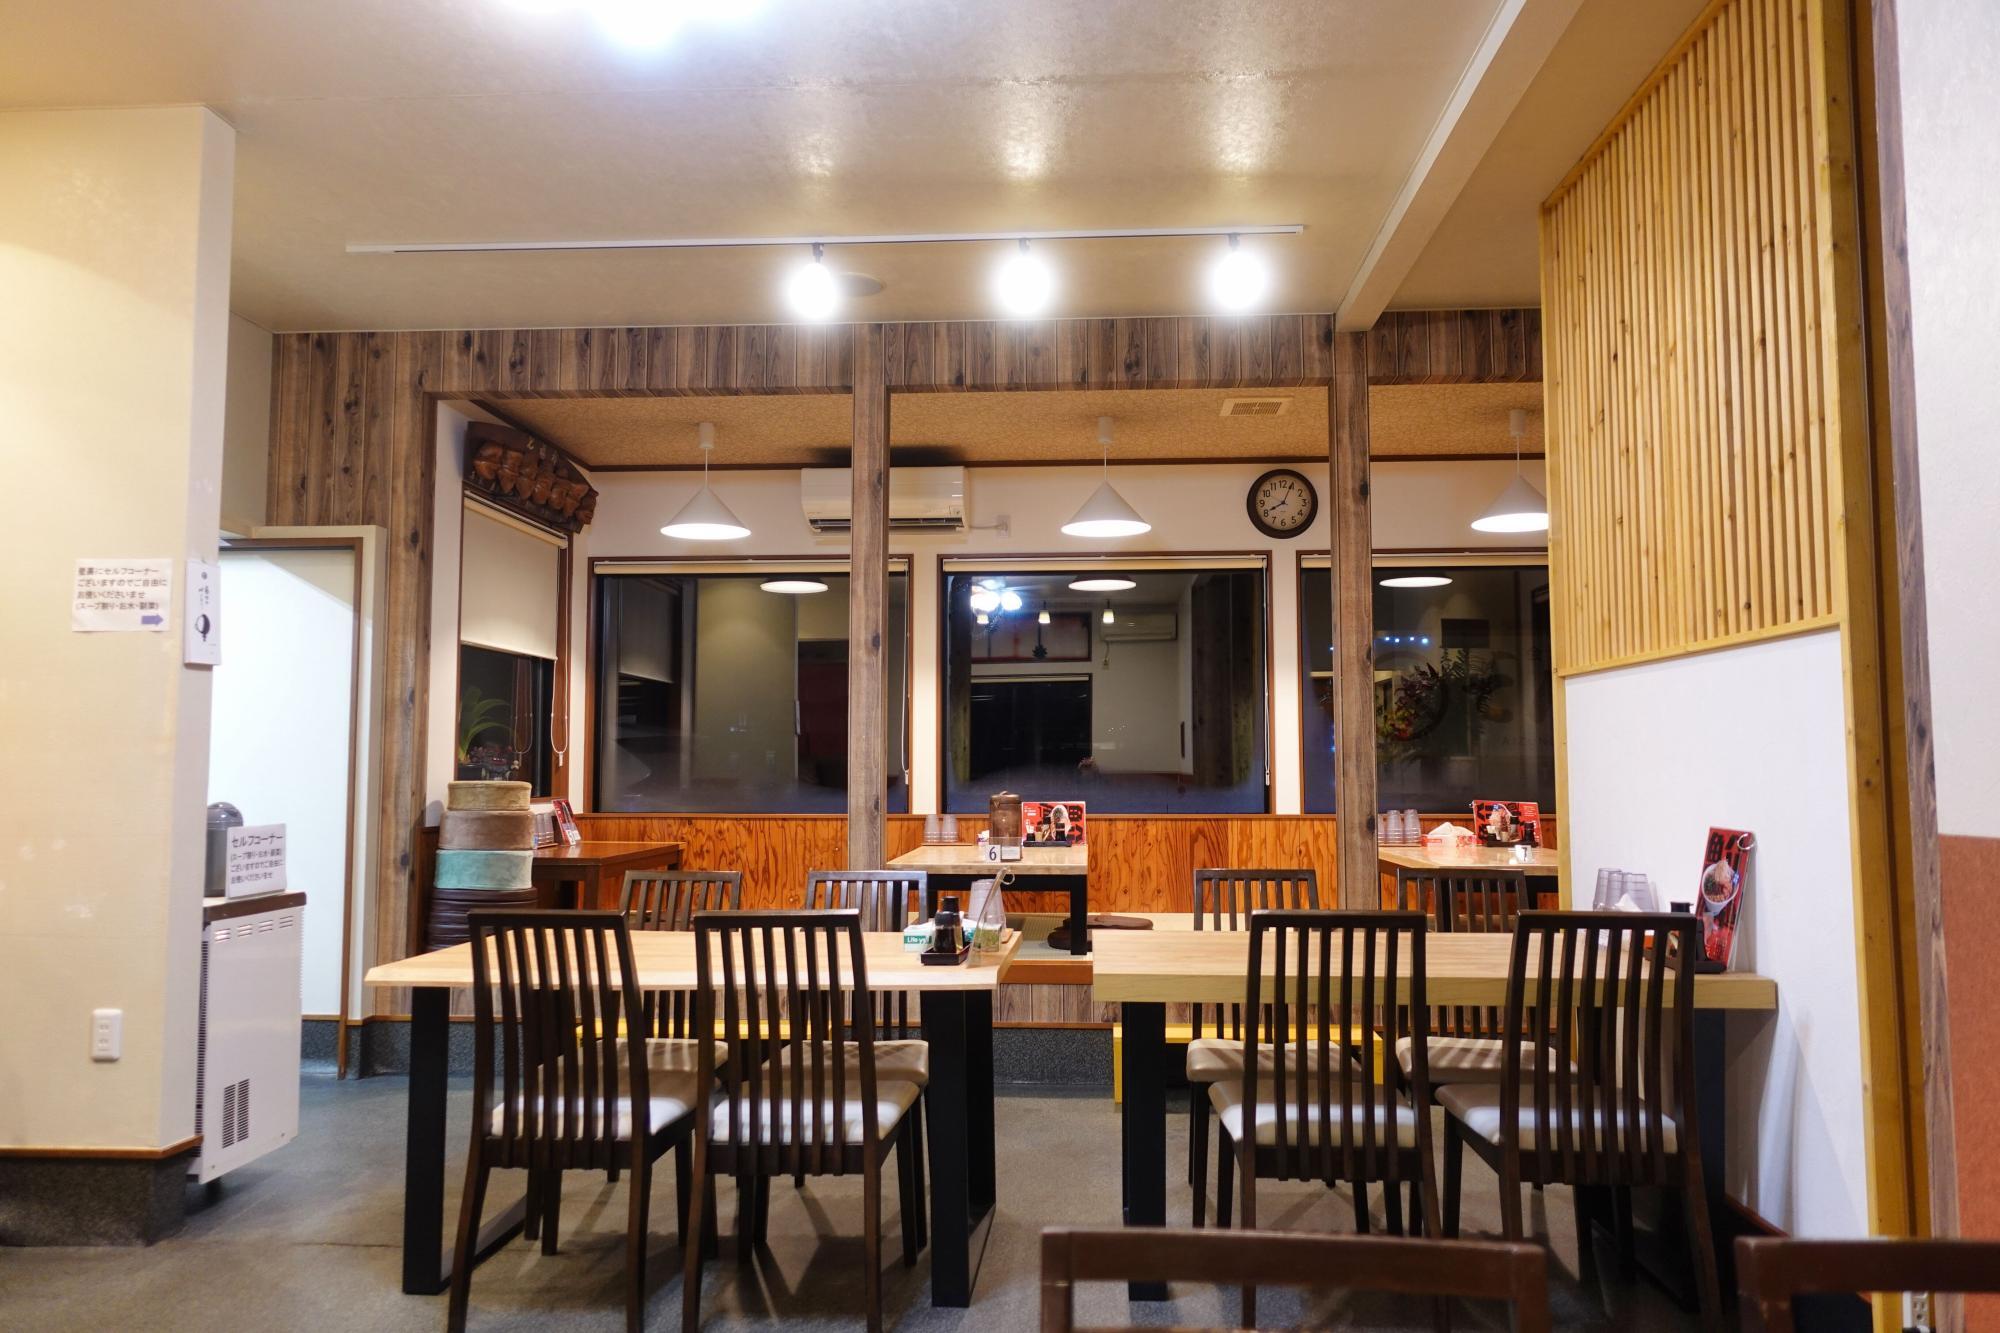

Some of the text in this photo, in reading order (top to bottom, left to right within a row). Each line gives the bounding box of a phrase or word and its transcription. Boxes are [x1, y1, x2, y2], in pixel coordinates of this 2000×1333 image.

[1270, 482, 1277, 491] 11
[1278, 480, 1287, 489] 12
[1262, 489, 1271, 498] 10
[1297, 488, 1303, 497] 2
[1259, 499, 1265, 508] 9
[1301, 498, 1307, 507] 3
[1263, 509, 1269, 517] 8
[1297, 509, 1303, 517] 4
[1271, 516, 1277, 525] 7
[1280, 519, 1286, 527] 6
[1291, 516, 1297, 524] 5
[232, 832, 284, 848] セルフコーナー
[989, 846, 997, 861] 6
